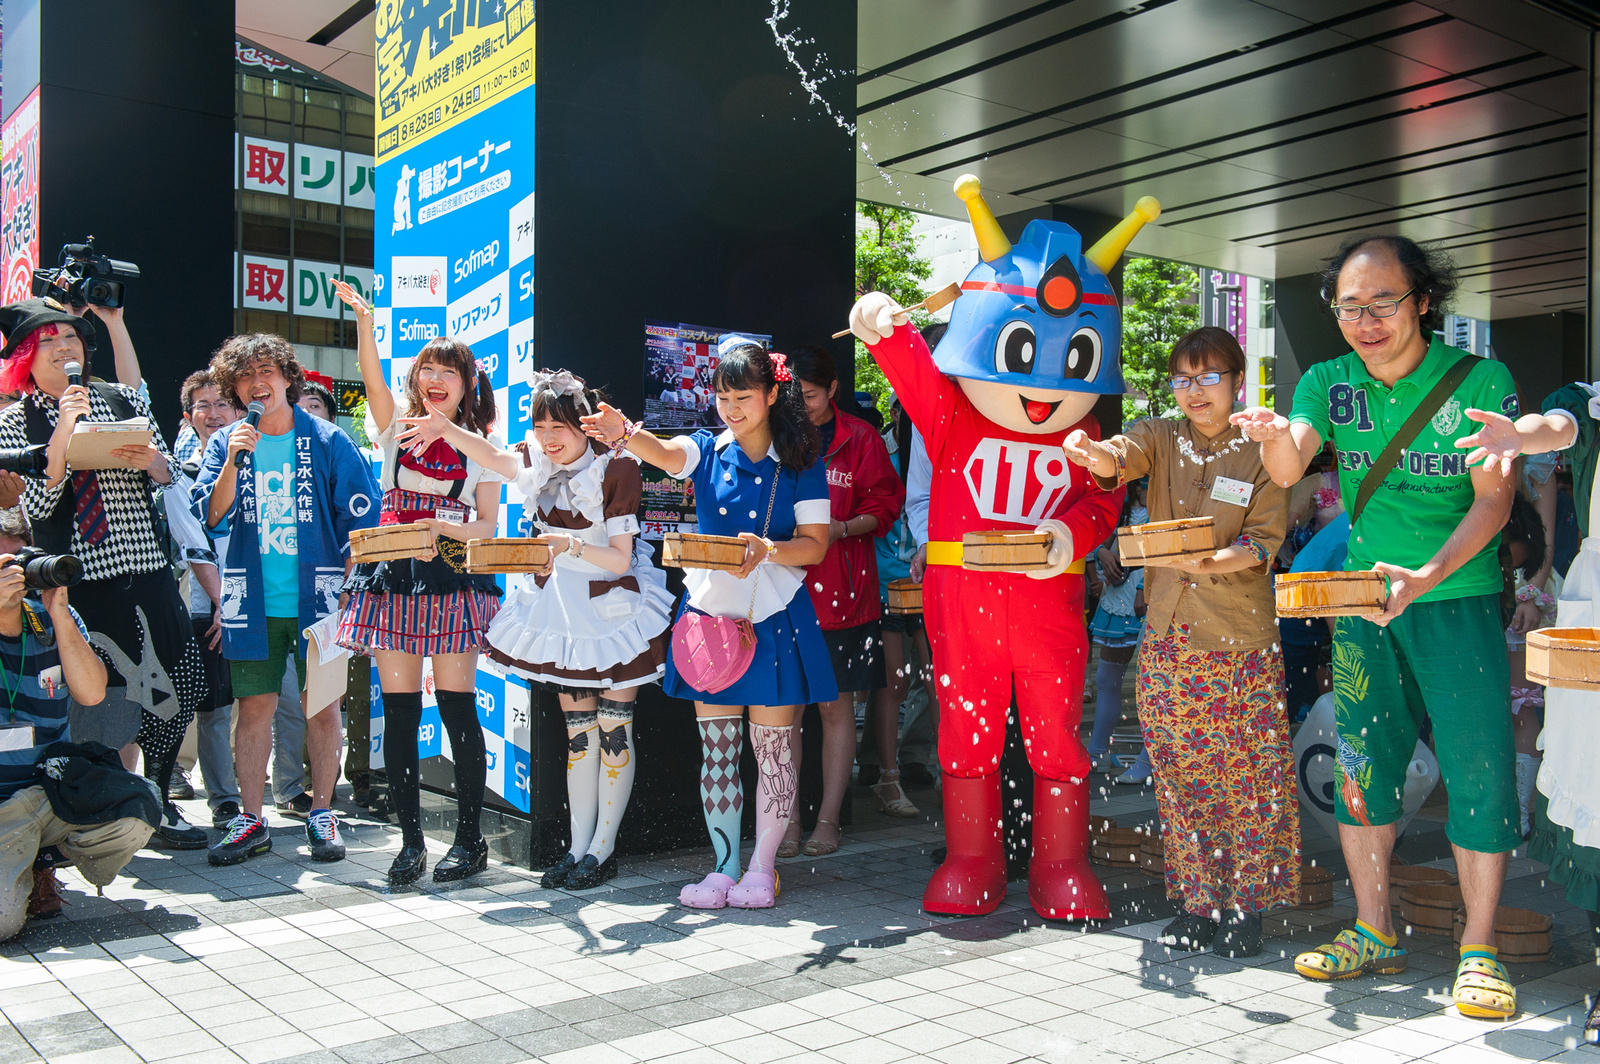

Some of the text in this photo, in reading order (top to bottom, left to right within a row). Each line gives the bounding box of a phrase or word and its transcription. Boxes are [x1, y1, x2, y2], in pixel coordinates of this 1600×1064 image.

[2, 126, 38, 213] アキバ
[246, 144, 286, 187] 取
[418, 140, 511, 202] 撮影コーナー
[245, 262, 286, 304] 取
[454, 239, 499, 284] Sofmap
[452, 292, 503, 336] ソフマップ
[1329, 382, 1375, 432] 81
[295, 436, 313, 523] 打ち水大作戦
[1388, 478, 1462, 496] Manufacturers
[30, 612, 44, 632] Nikon
